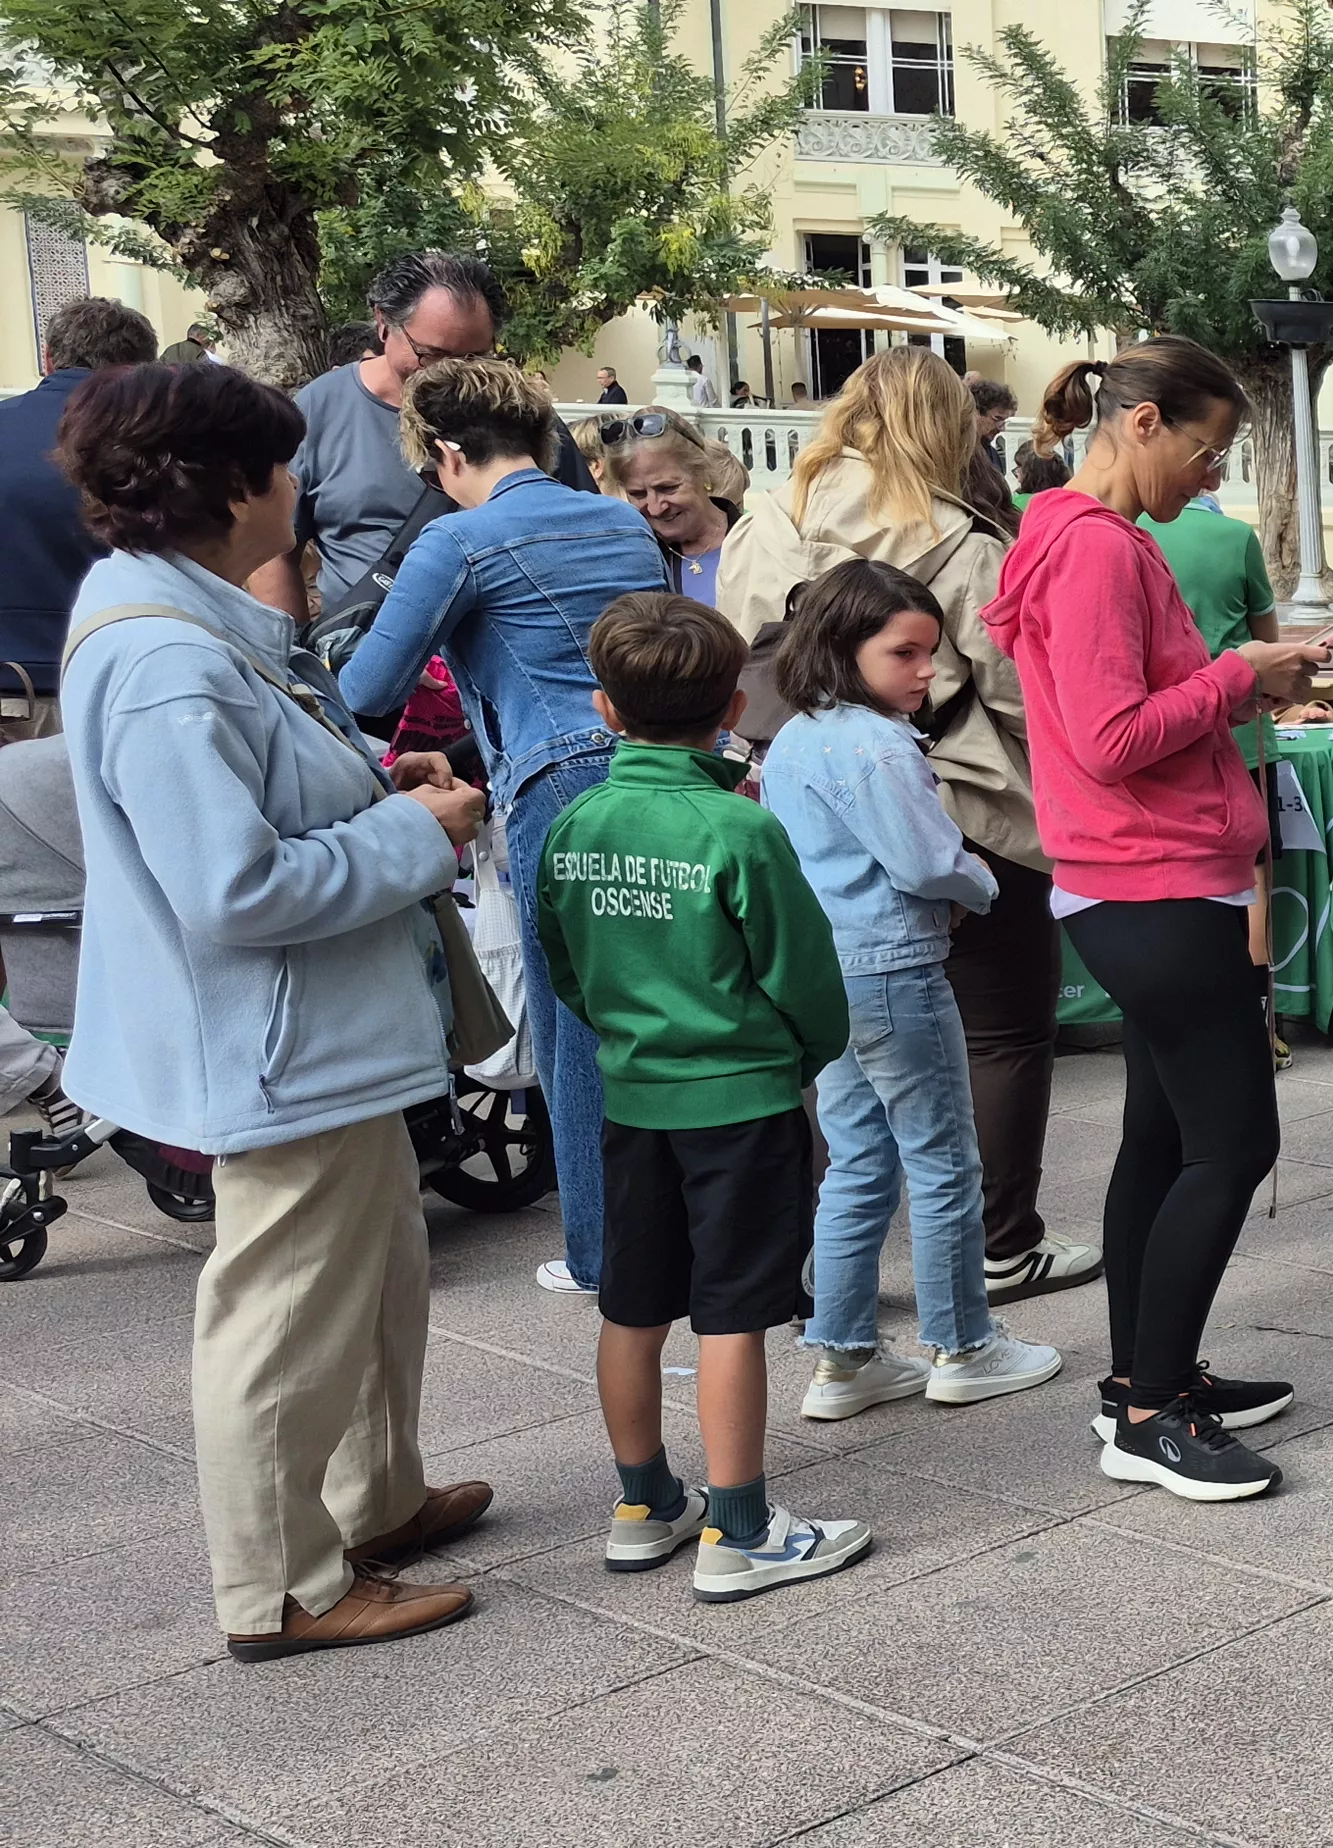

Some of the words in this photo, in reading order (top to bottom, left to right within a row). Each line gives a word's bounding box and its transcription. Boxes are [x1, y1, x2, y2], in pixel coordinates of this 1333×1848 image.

[1277, 796, 1307, 812] 1-3
[553, 851, 622, 882] ESCUELA
[625, 855, 647, 885] DE
[650, 858, 711, 893] FUTBOL
[591, 887, 674, 920] OSCENSE
